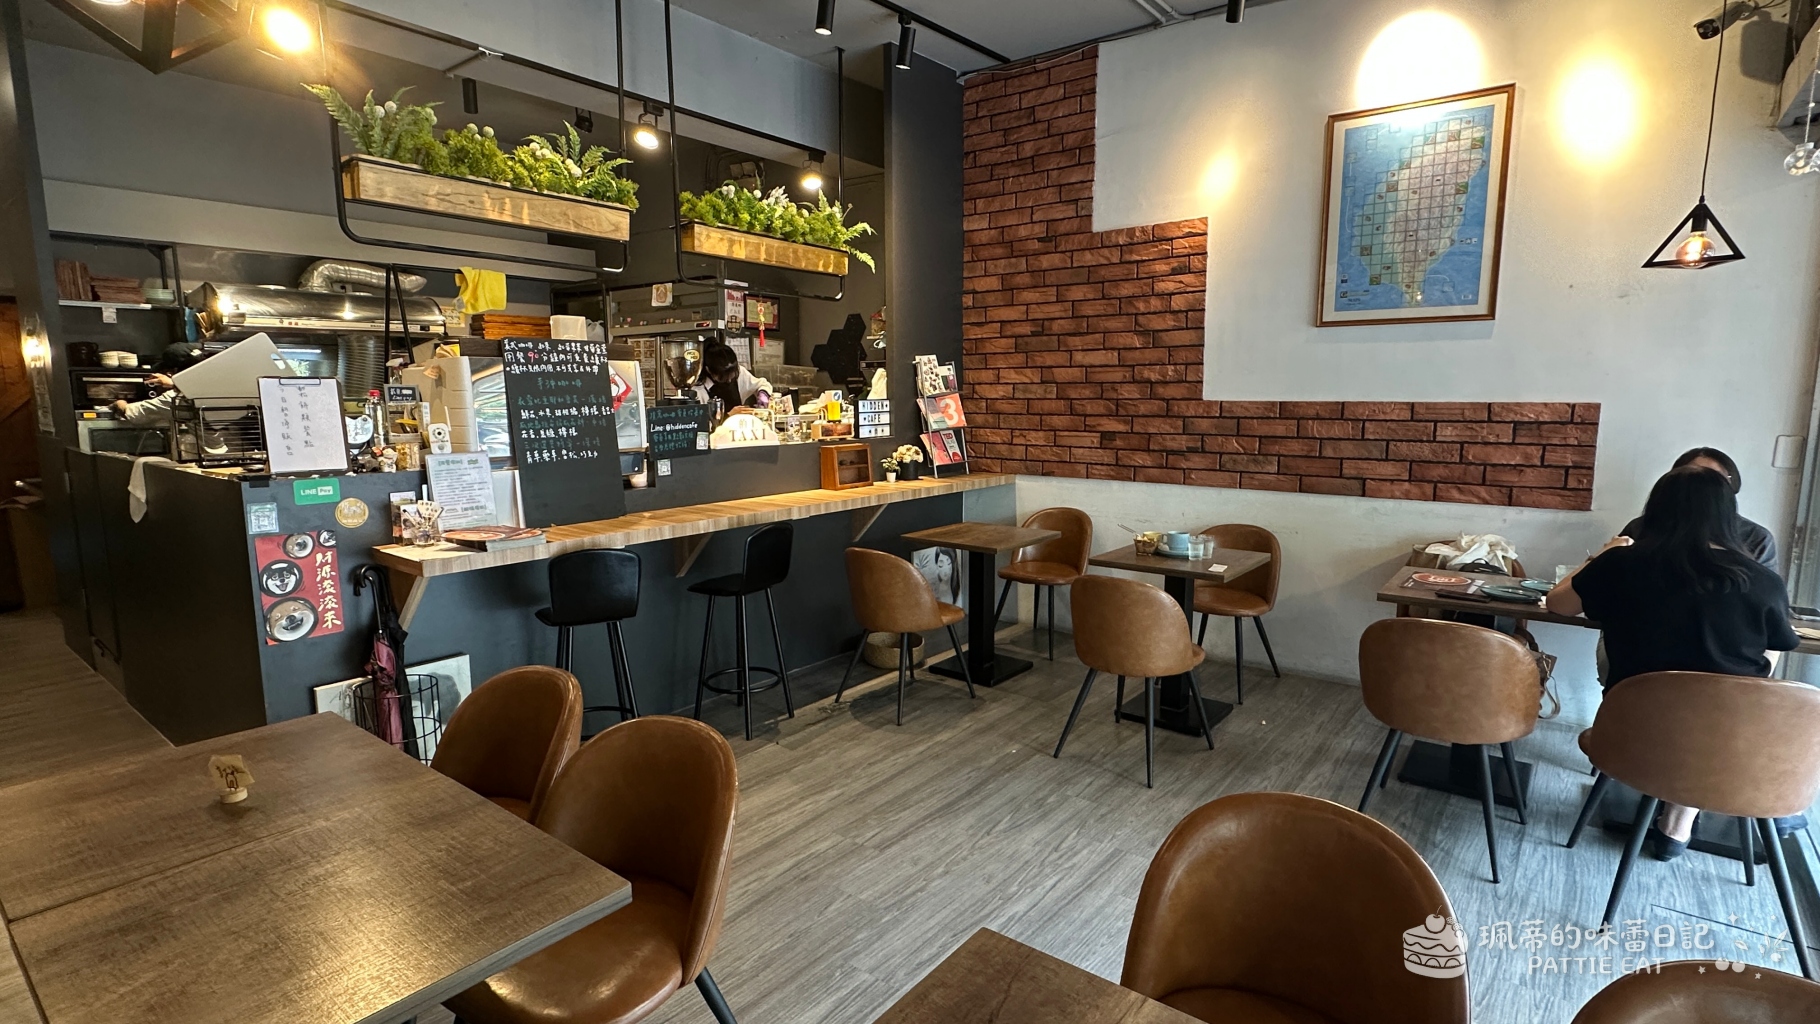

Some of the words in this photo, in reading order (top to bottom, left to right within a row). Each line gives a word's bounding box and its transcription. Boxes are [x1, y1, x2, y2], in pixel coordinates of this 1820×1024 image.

[867, 413, 881, 423] CAFE
[940, 398, 959, 426] 3
[729, 428, 766, 442] TAXI
[301, 488, 317, 496] LINE
[315, 551, 342, 630] 財源滾滾來
